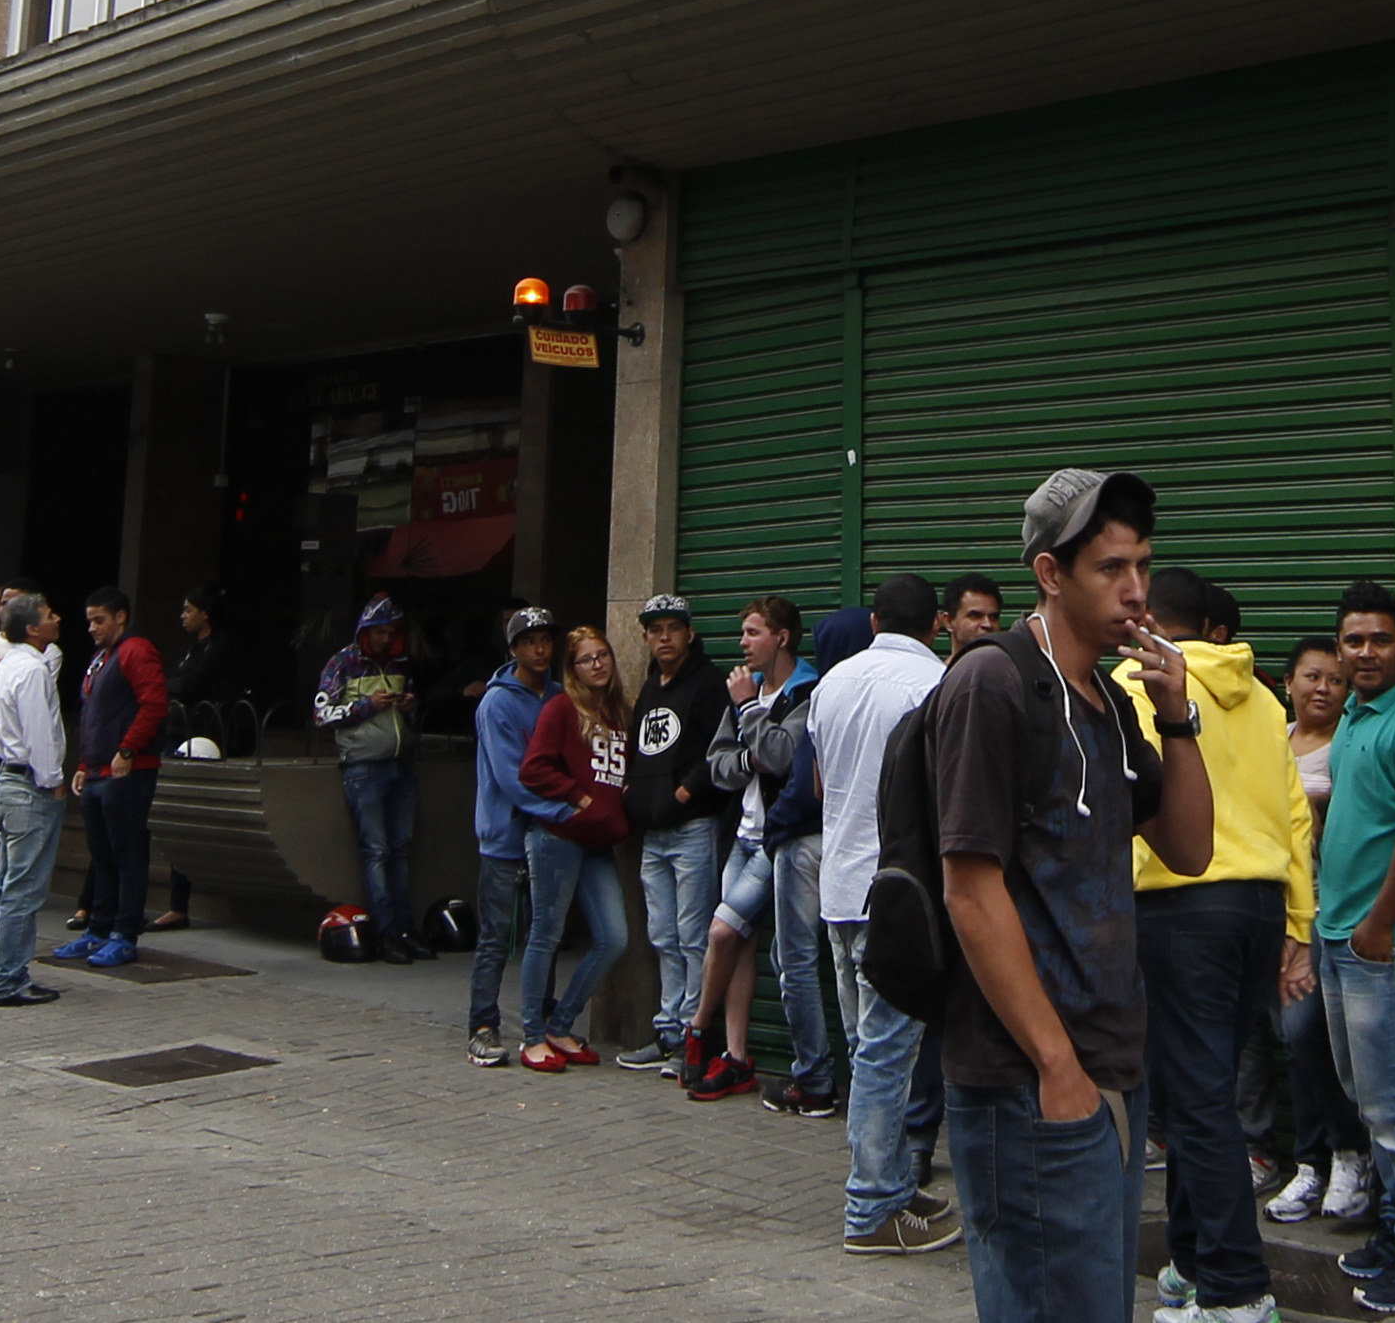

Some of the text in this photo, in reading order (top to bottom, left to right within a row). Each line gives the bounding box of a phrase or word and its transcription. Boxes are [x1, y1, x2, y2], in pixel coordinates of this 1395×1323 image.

[535, 329, 588, 345] CUIDADO
[533, 342, 594, 357] VEÍCULOS
[591, 736, 626, 776] 95
